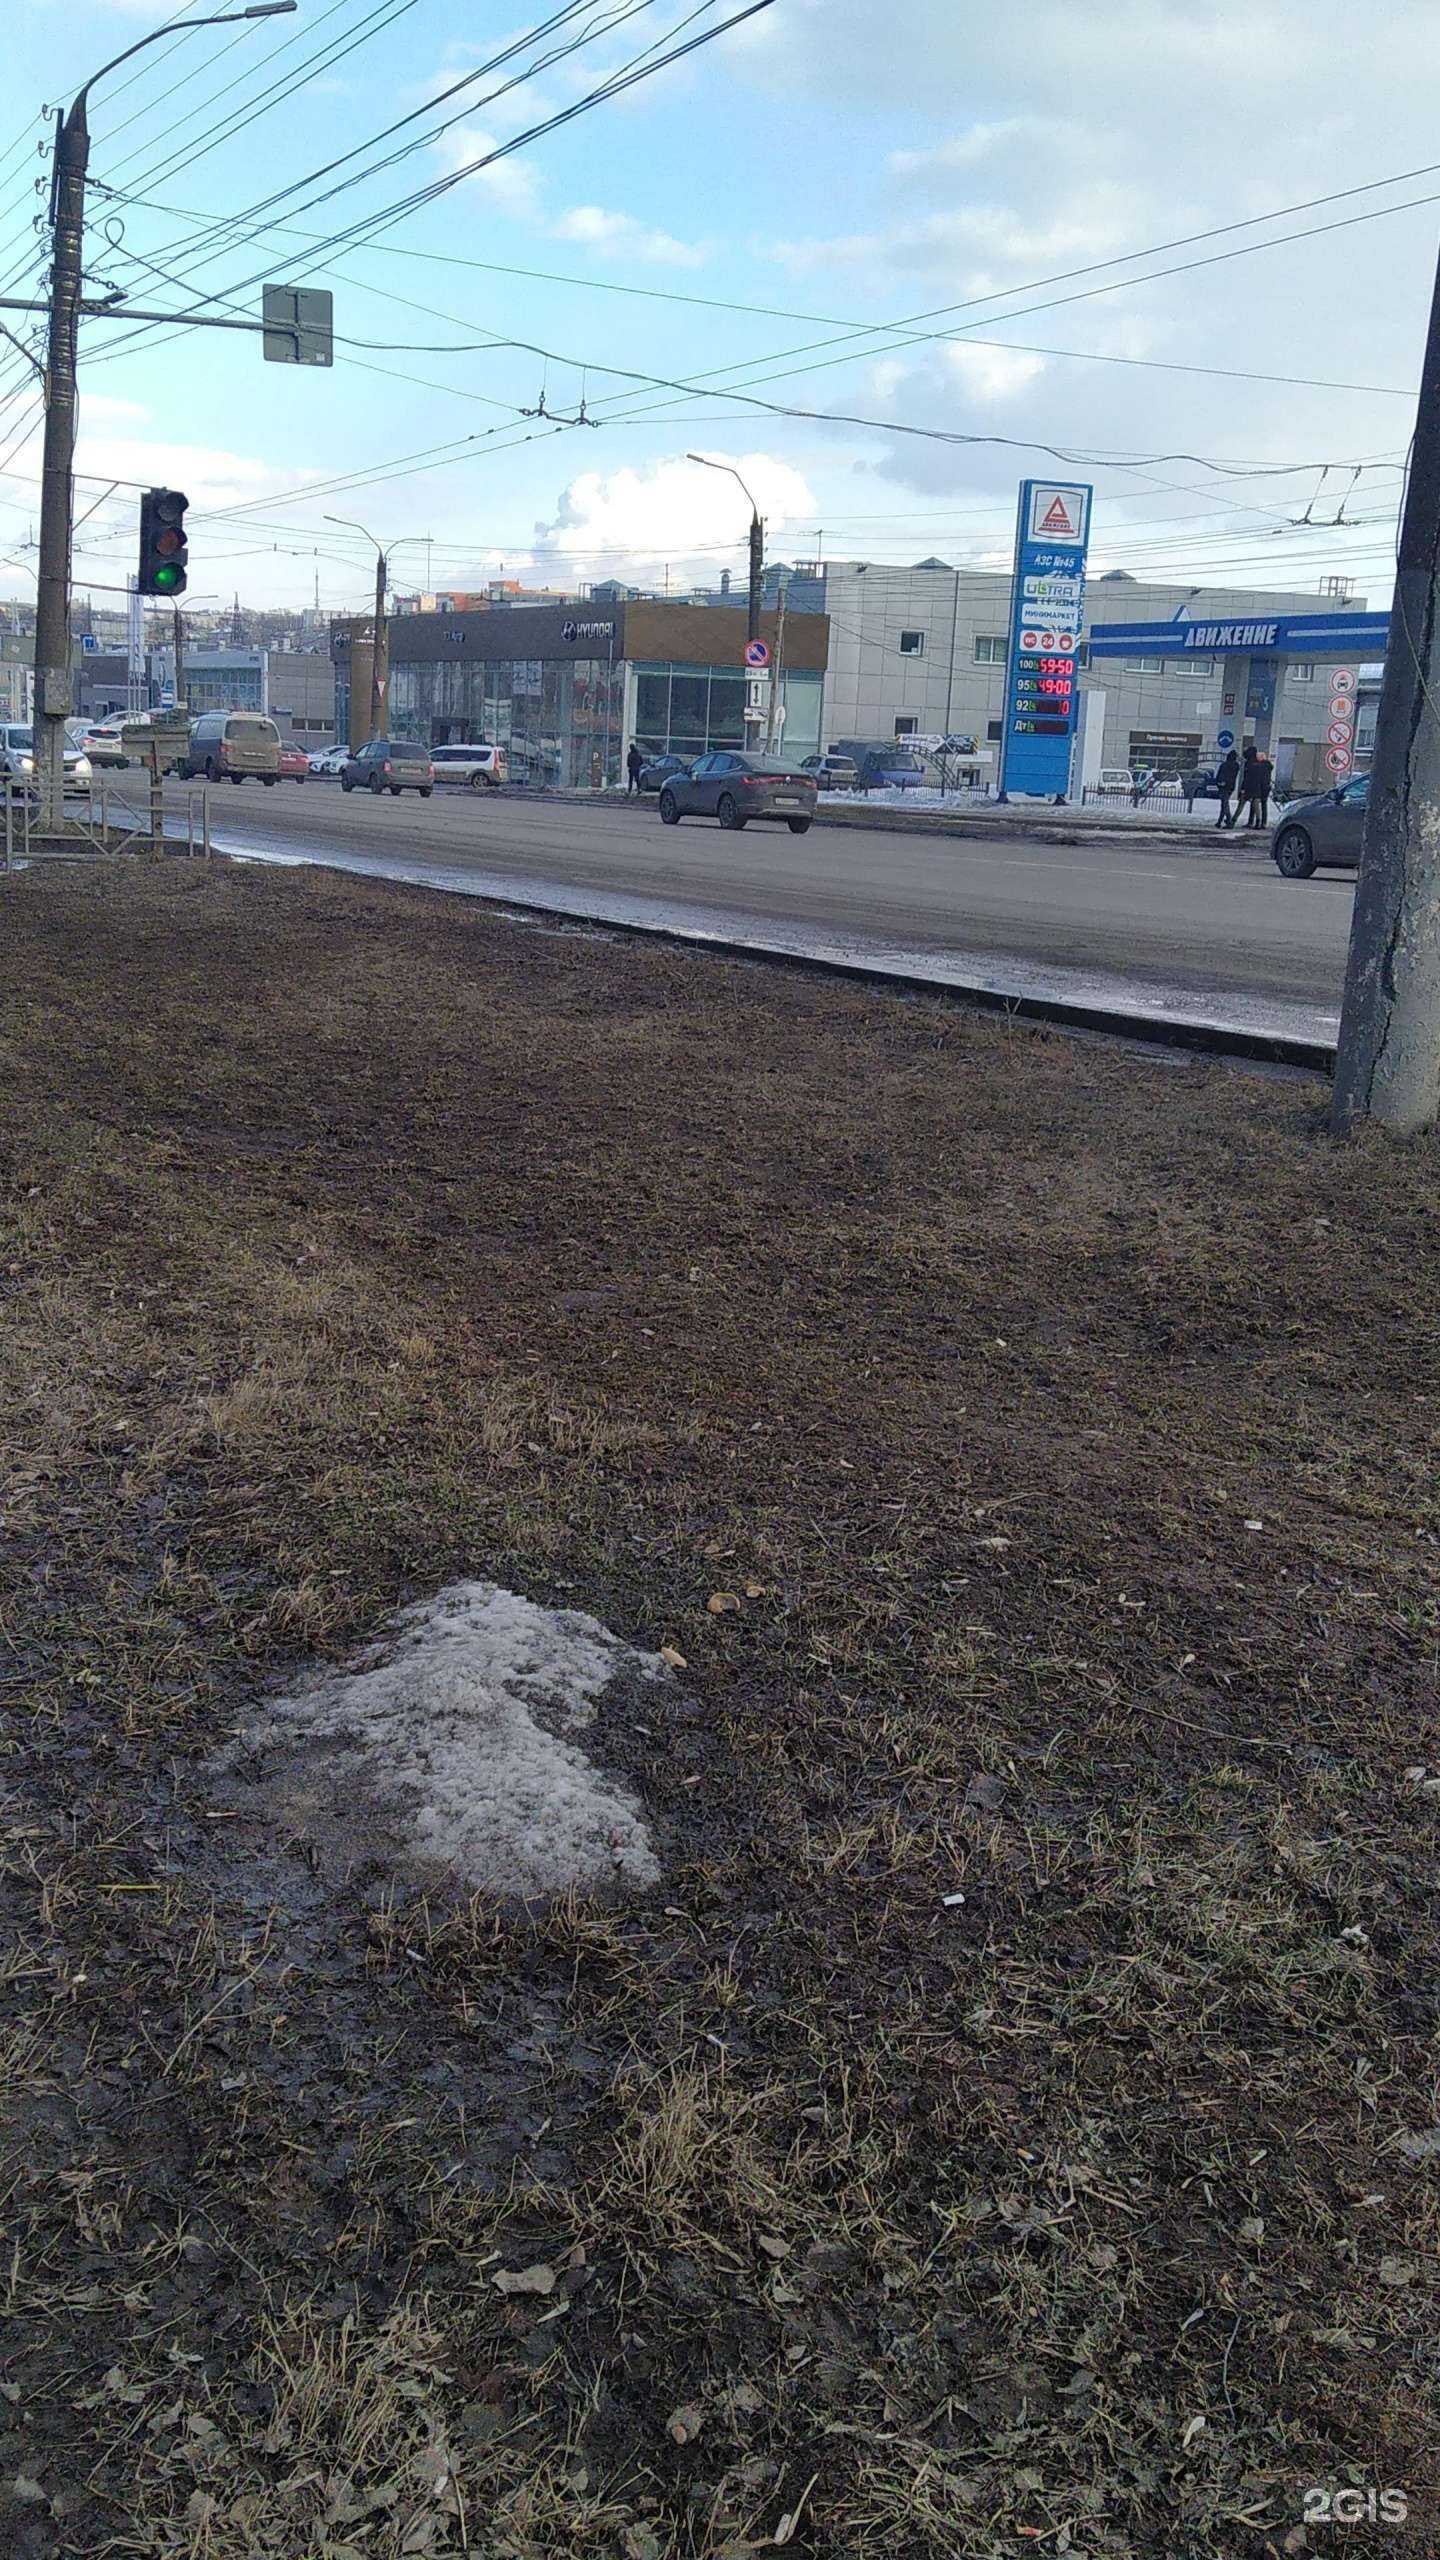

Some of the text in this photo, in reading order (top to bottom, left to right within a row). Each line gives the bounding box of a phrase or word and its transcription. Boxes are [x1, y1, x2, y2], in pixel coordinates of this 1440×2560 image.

[1034, 554, 1052, 566] АЗС
[576, 621, 614, 639] HYUNDAI
[1184, 624, 1278, 647] ДВИЖЕНИЕ
[1042, 636, 1053, 646] 24
[1019, 659, 1033, 669] 100
[1017, 679, 1030, 691] 95
[1015, 699, 1029, 711] 92
